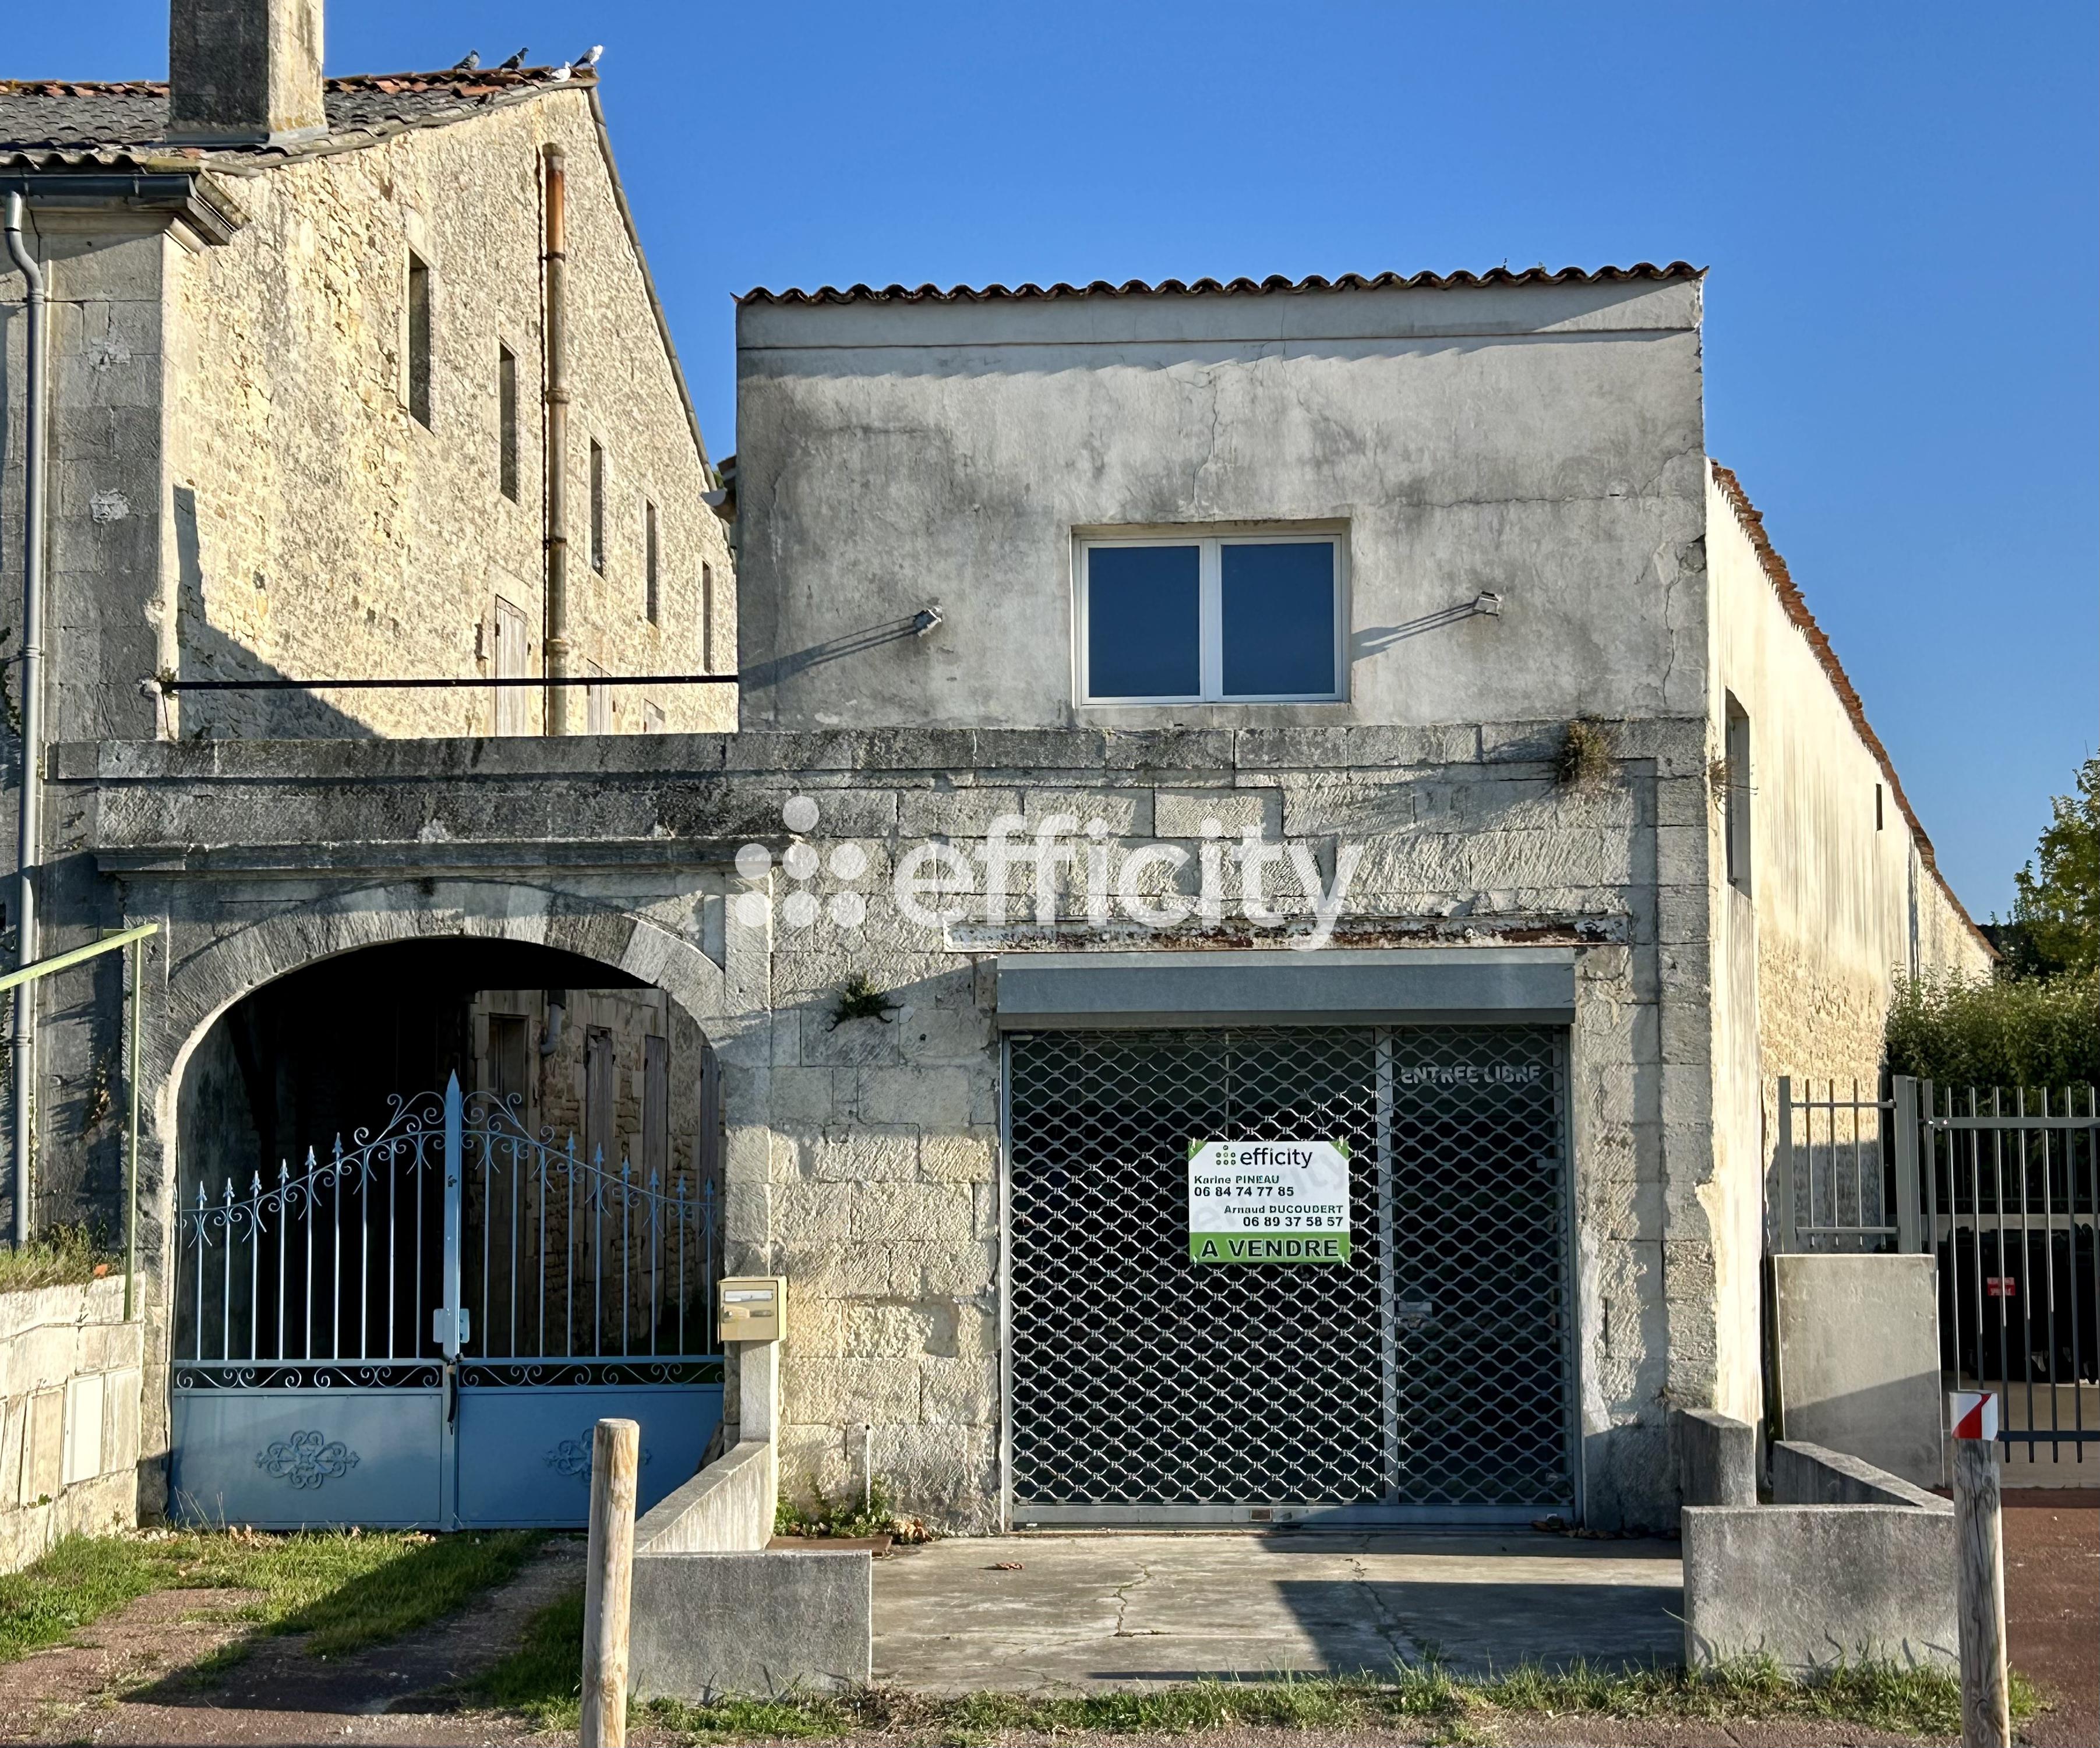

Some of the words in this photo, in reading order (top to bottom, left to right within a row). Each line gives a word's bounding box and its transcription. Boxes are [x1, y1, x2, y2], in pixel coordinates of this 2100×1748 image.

[1240, 1147, 1313, 1168] efficity
[1194, 1175, 1231, 1184] Karine
[1236, 1175, 1280, 1184] PINEAU
[1194, 1186, 1210, 1196] 06
[1215, 1186, 1231, 1196] 84
[1236, 1186, 1252, 1196] 74
[1257, 1186, 1273, 1196] 77
[1277, 1186, 1294, 1196] 85
[1224, 1205, 1265, 1214] Arnaud
[1243, 1217, 1259, 1227] 06
[1264, 1217, 1280, 1227] 89
[1285, 1217, 1301, 1227] 37
[1306, 1217, 1322, 1227] 58
[1327, 1217, 1343, 1227] 57
[1201, 1240, 1219, 1257] A
[1228, 1240, 1339, 1257] VENDRE
